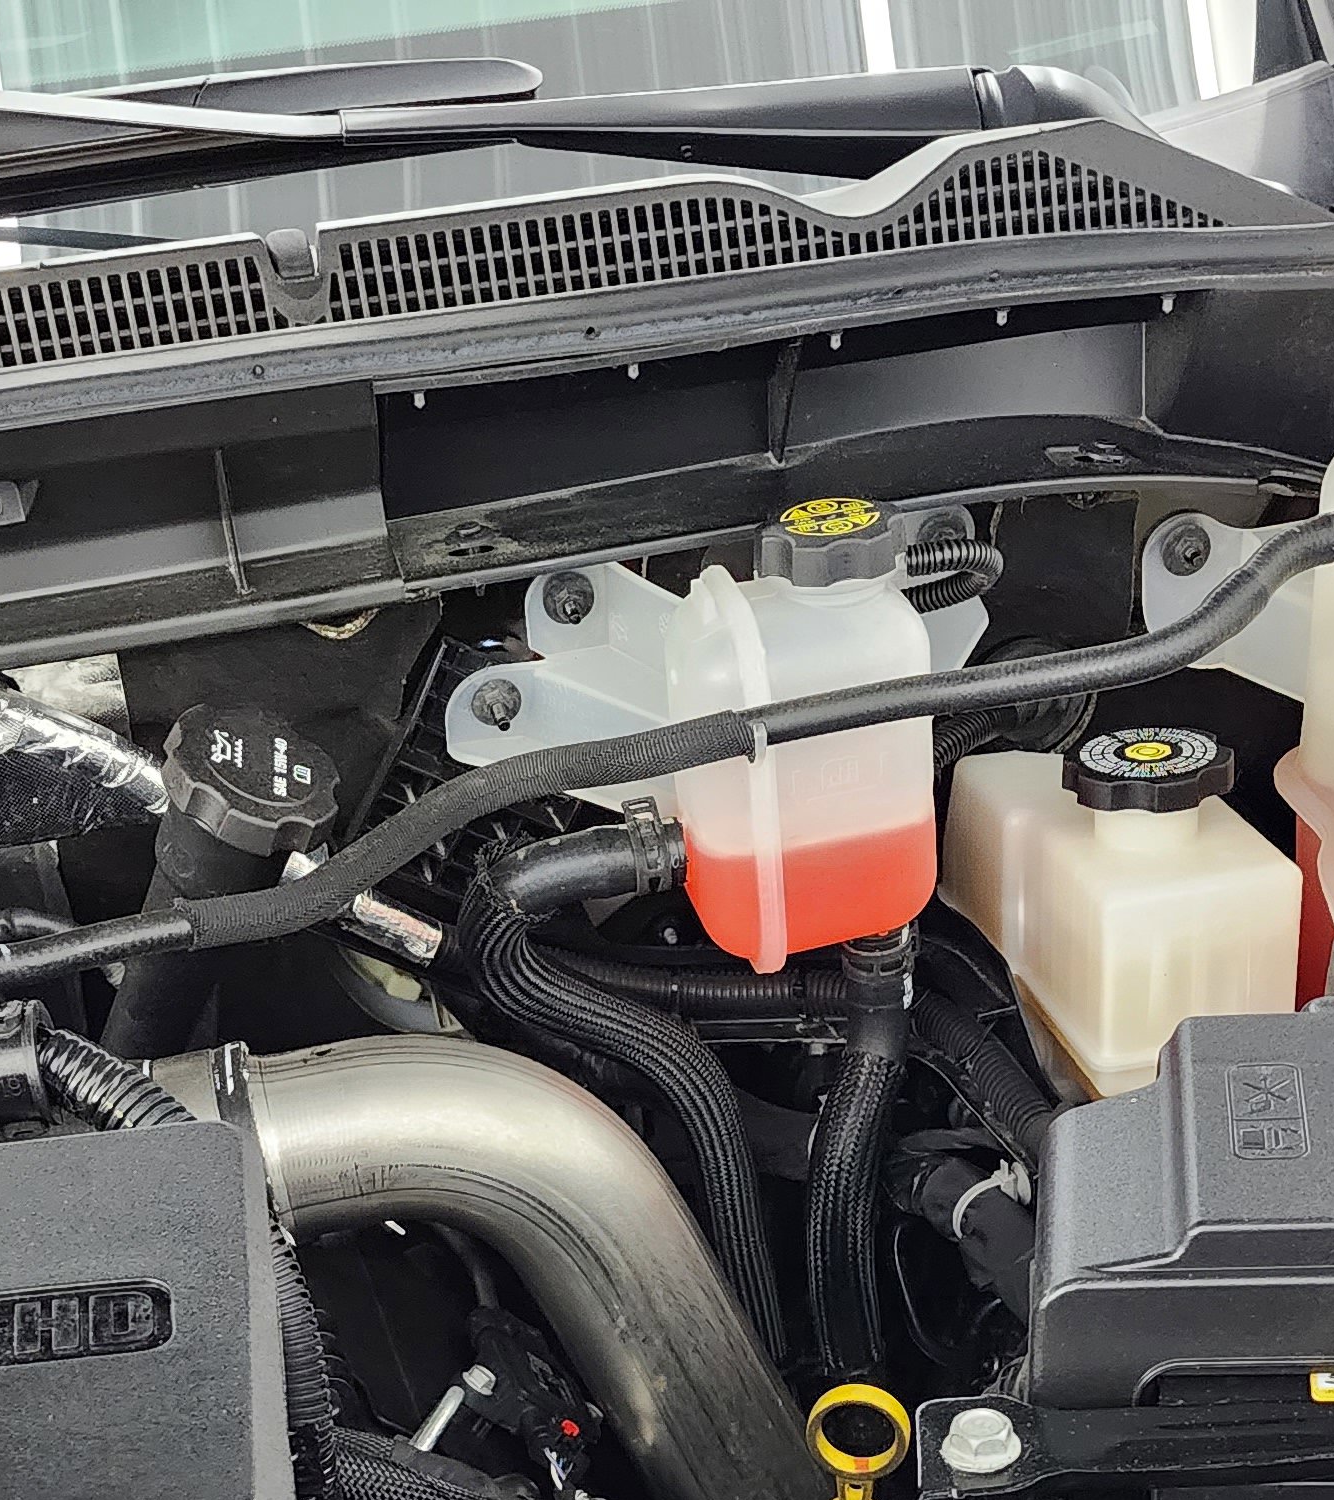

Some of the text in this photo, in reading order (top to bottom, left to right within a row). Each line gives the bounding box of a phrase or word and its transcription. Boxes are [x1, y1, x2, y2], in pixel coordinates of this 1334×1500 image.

[272, 737, 288, 797] SAE 15W-40
[12, 1289, 155, 1357] HD
